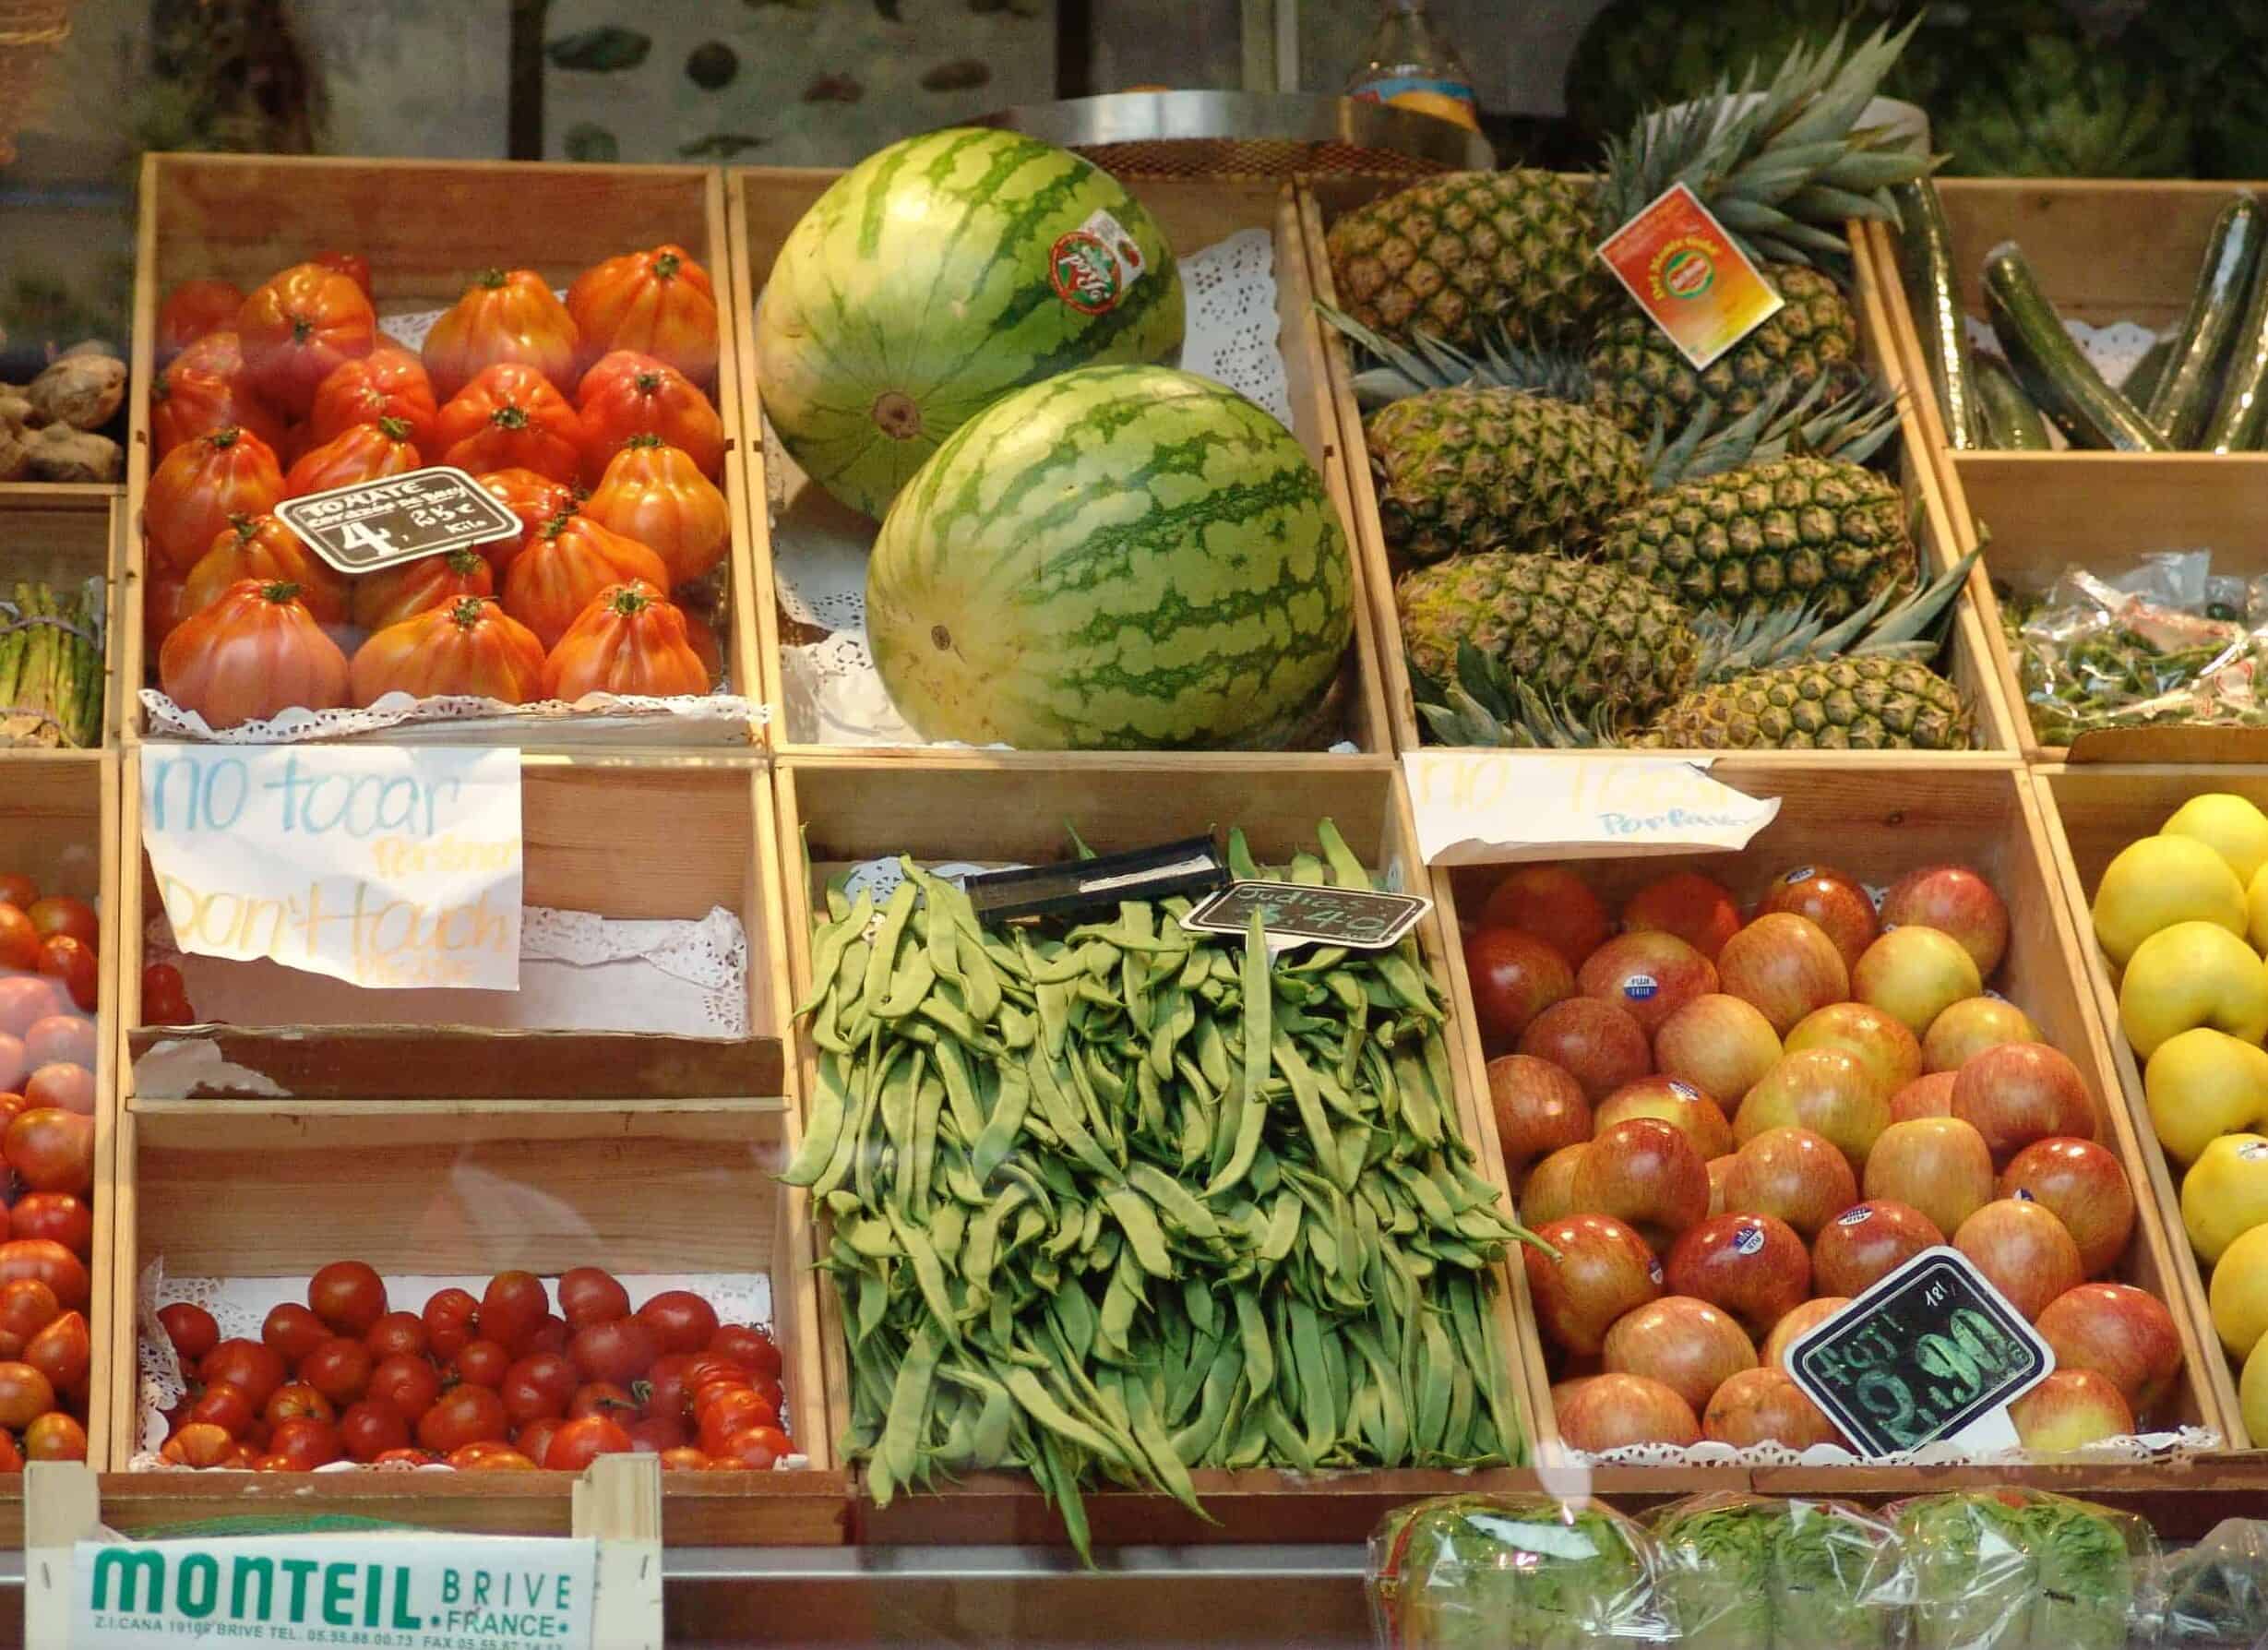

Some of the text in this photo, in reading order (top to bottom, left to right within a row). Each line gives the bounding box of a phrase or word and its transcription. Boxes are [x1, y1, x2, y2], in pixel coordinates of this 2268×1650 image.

[301, 481, 425, 517] TOMATE
[263, 751, 460, 838] tocar
[441, 1568, 571, 1610] BRIVE
[217, 1622, 264, 1639] BRIVE
